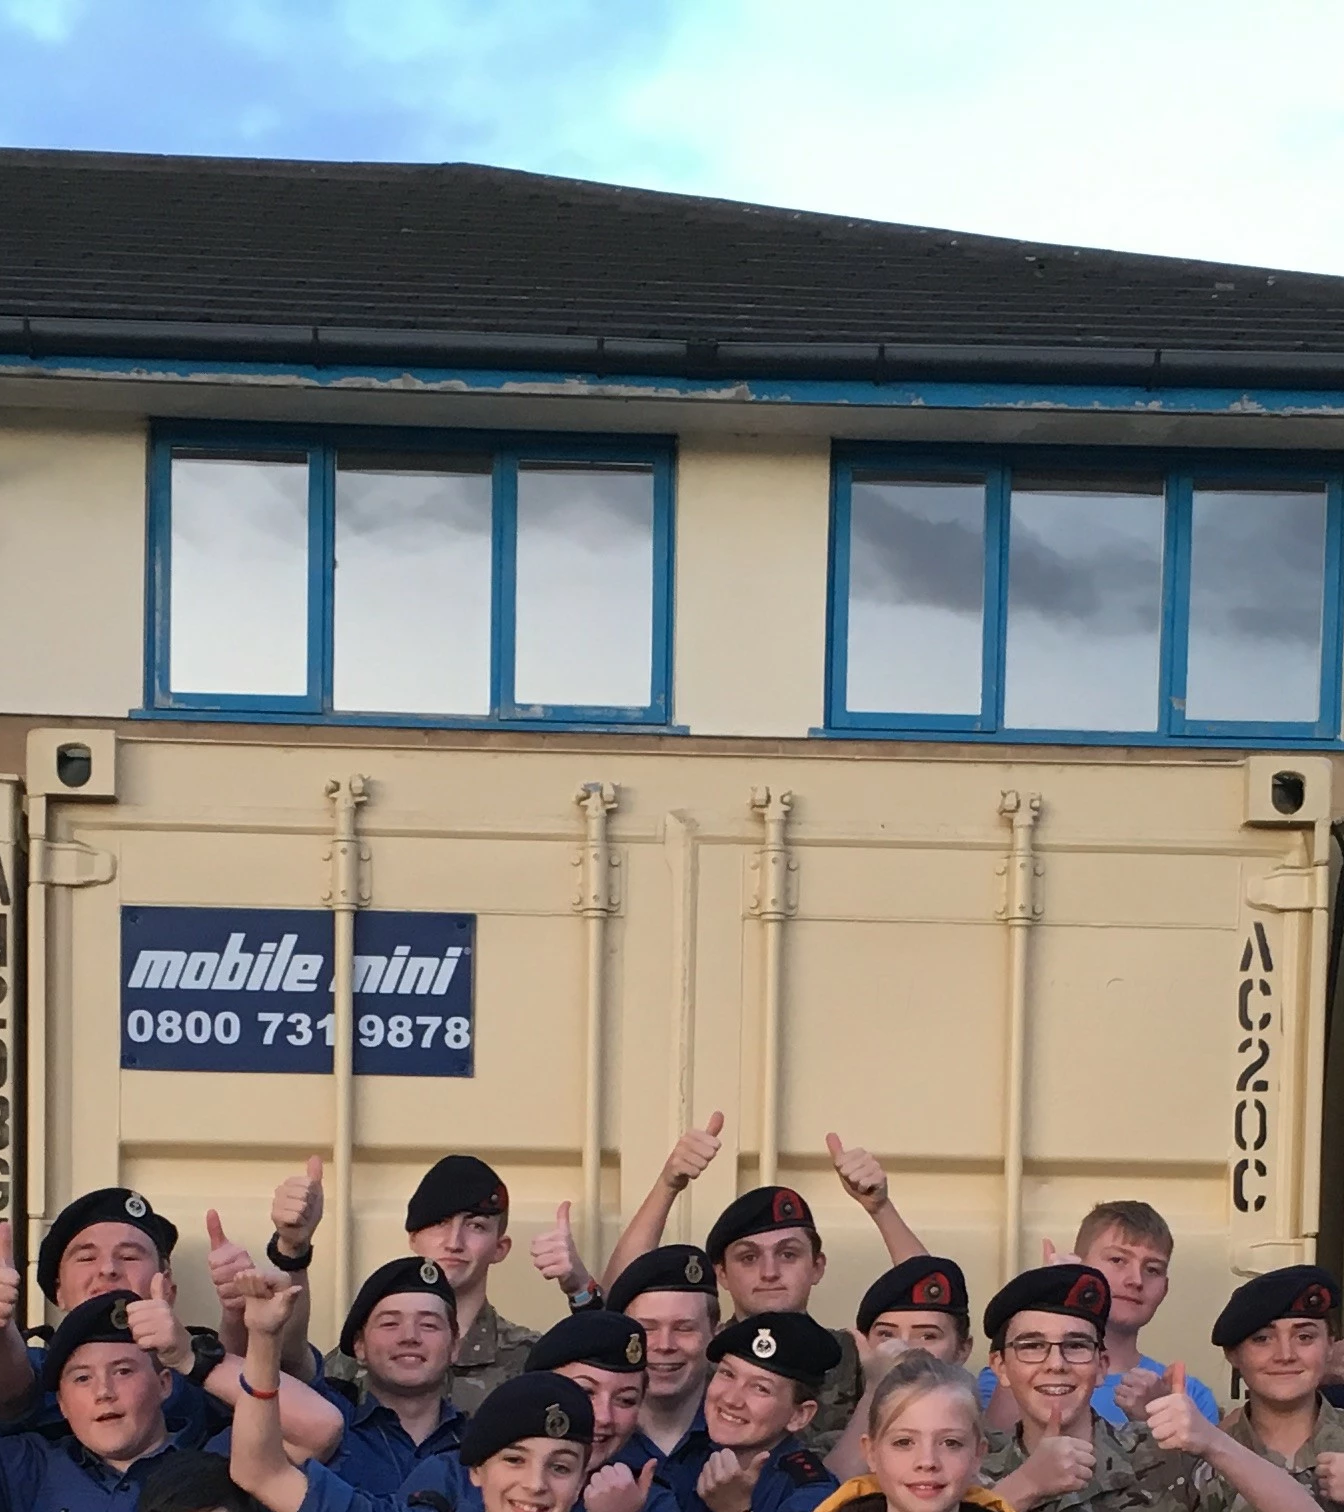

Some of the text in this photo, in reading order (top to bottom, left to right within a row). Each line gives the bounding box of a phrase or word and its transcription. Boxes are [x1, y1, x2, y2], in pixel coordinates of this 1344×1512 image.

[127, 932, 324, 992] mobile
[127, 1009, 471, 1049] 0800 731 9878
[1233, 921, 1274, 1213] AC20C
